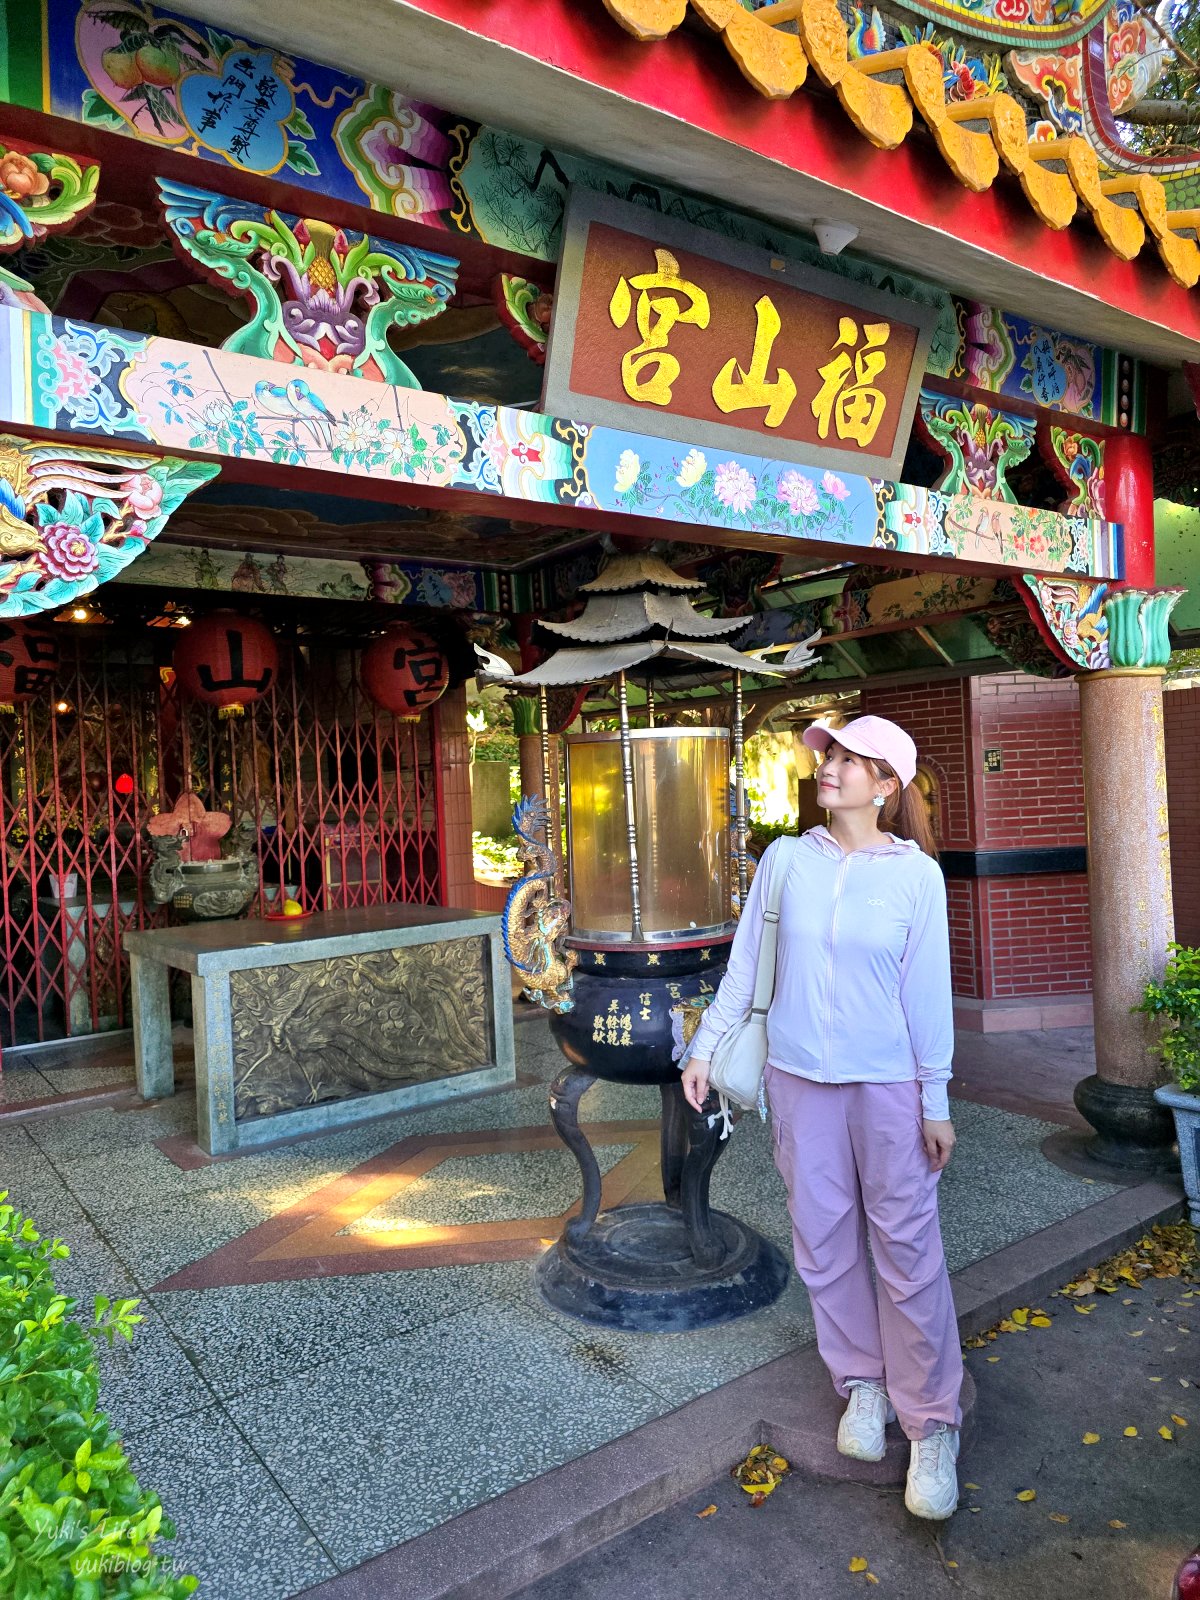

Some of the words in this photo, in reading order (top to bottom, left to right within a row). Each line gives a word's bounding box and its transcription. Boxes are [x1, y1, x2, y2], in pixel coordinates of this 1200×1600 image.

[228, 75, 279, 163] 敬老尊賢
[608, 248, 892, 448] 福山宮
[196, 629, 272, 693] 山
[393, 639, 448, 707] 宮
[638, 992, 653, 1021] 信士
